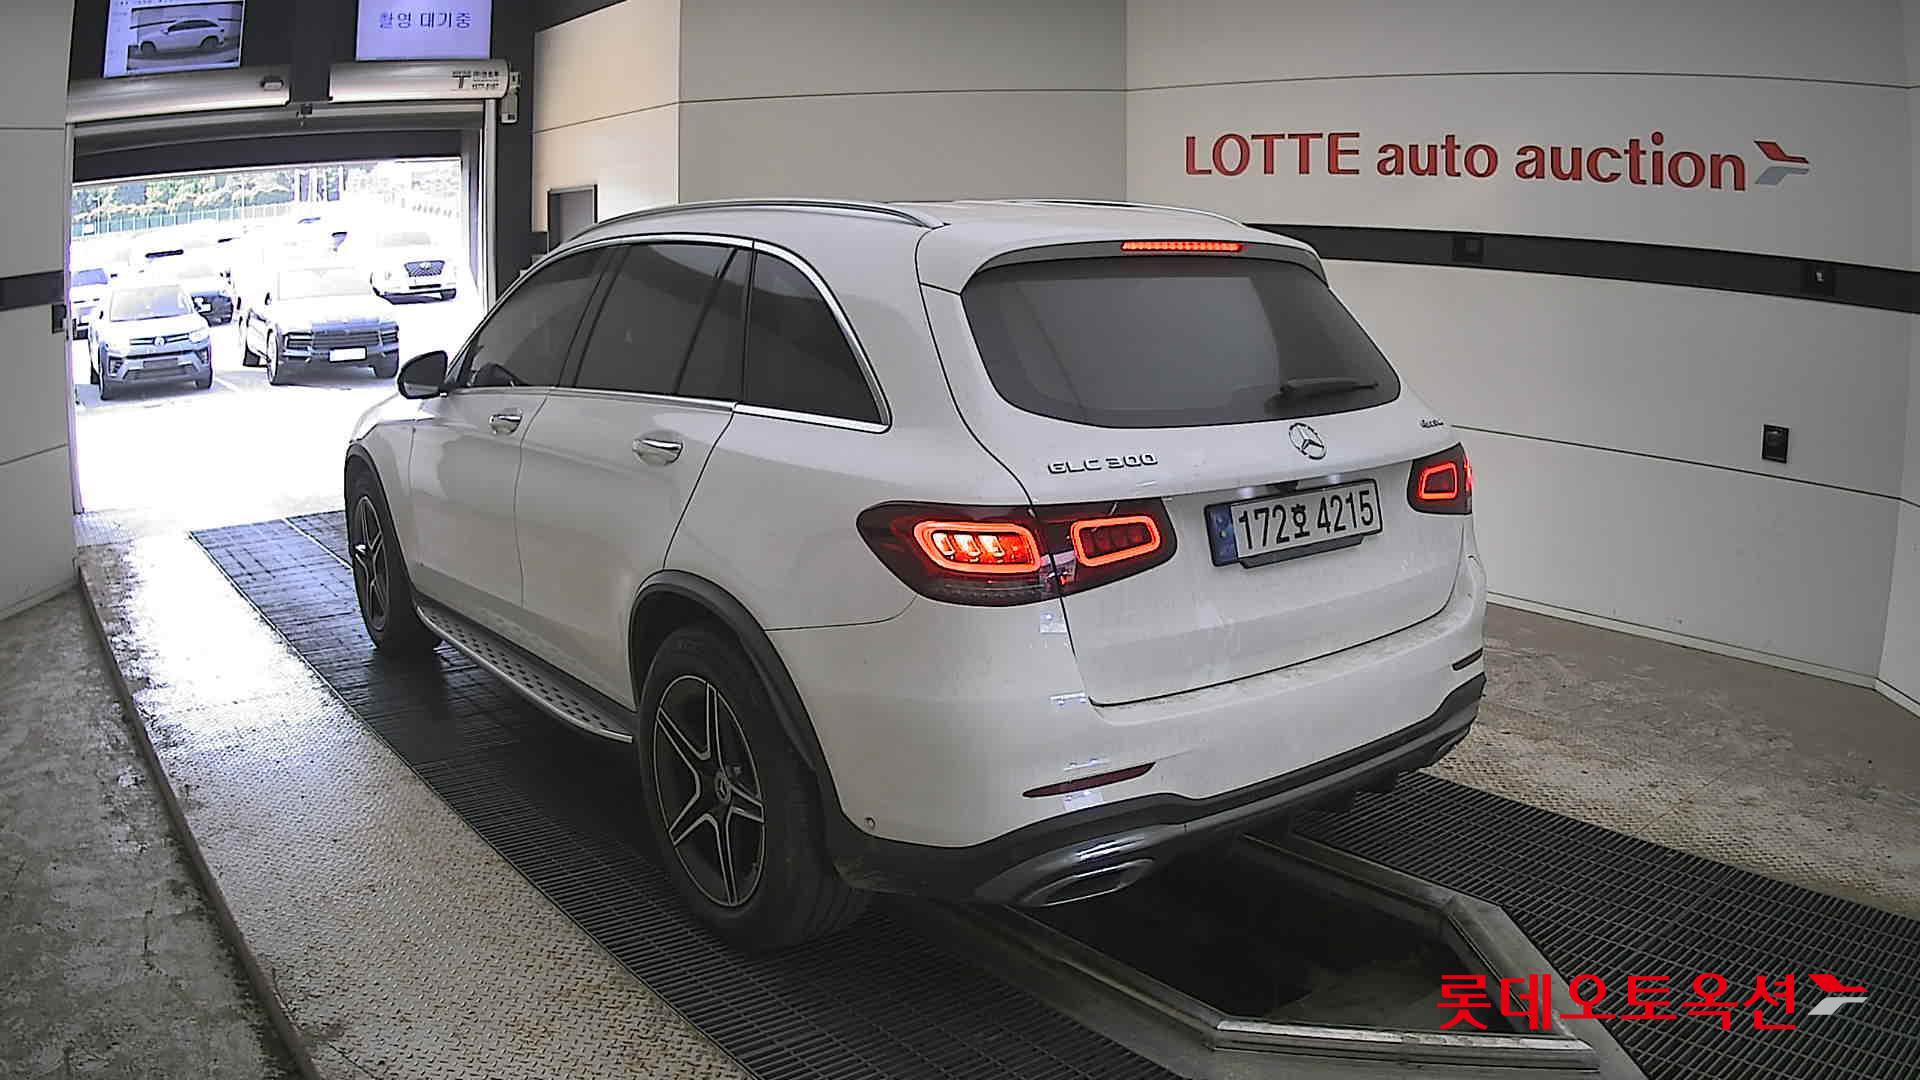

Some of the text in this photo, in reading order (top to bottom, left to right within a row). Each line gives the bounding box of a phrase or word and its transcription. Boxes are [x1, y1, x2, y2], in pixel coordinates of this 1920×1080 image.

[420, 12, 473, 30] 대기중
[1184, 131, 1748, 192] LOTTE auto auction
[1047, 453, 1159, 475] GLC 300
[1238, 489, 1375, 550] 172호 4215
